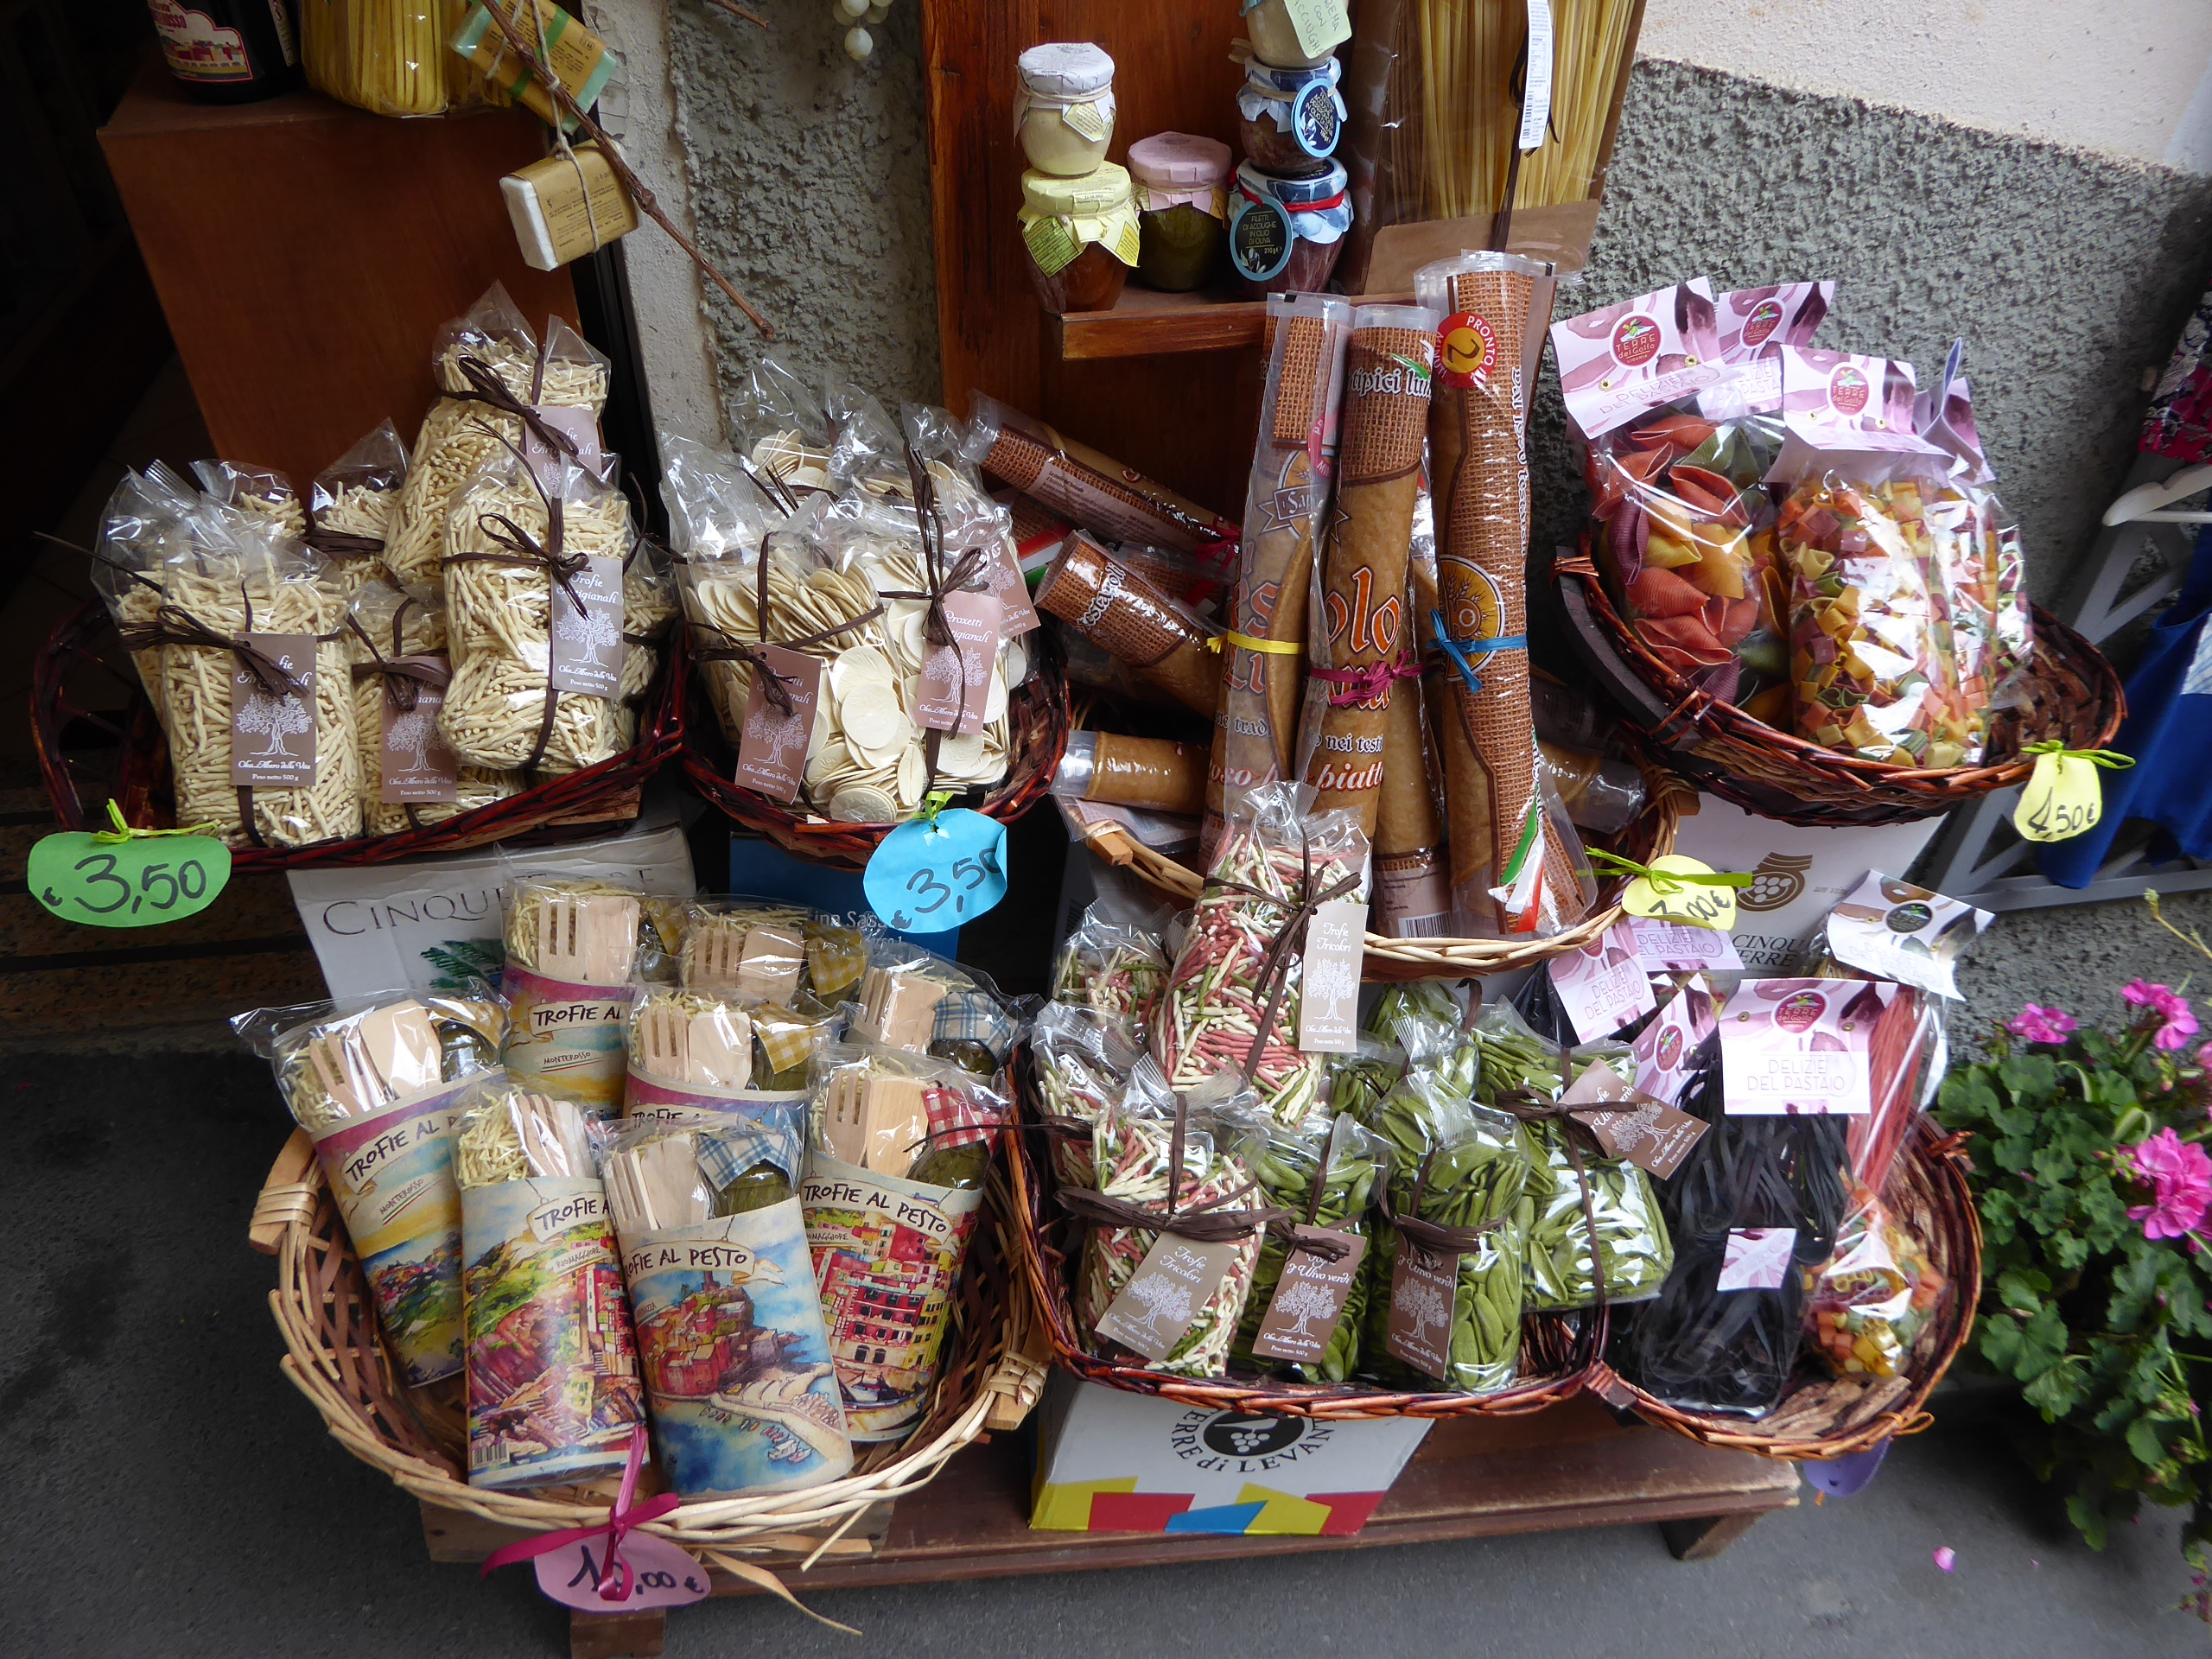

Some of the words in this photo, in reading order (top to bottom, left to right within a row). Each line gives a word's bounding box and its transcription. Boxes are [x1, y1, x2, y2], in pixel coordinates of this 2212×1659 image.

[1313, 4, 1328, 28] CON
[1249, 221, 1277, 230] ACCIUGHE
[1745, 320, 1776, 336] TERRE
[1466, 315, 1495, 366] PRONTO
[1615, 334, 1656, 353] TERRE
[1446, 338, 1480, 363] 2
[1618, 346, 1631, 359] del
[1631, 342, 1656, 356] Golfo
[1599, 398, 1631, 415] DEL
[1637, 374, 1712, 402] PASTAIO
[1615, 372, 1683, 403] DELIZIE
[1833, 385, 1866, 399] TERRE
[569, 570, 604, 589] Trofie
[570, 678, 583, 688] Peso
[583, 680, 595, 690] netto
[595, 681, 606, 690] 500
[605, 671, 618, 683] Vita
[279, 760, 296, 770] della
[295, 760, 312, 771] Vita
[73, 853, 207, 915] 3,50
[1323, 922, 1350, 940] Trofie
[1637, 930, 1692, 944] DELIZIE
[1317, 937, 1352, 952] Tricolori
[1657, 942, 1715, 956] PASTAIO
[1735, 950, 1799, 969] ERRE
[1591, 969, 1628, 1000] DELIZIE
[1584, 1001, 1608, 1020] DEL
[1606, 981, 1642, 1013] PASTAIO
[532, 1004, 599, 1027] TROFIE
[1778, 1007, 1818, 1017] TERRE
[543, 1051, 592, 1065] MONTEROSSO
[1768, 1058, 1827, 1074] DELIZIE
[1747, 1075, 1779, 1090] DEL
[1783, 1075, 1846, 1090] PASTAIO
[346, 1130, 410, 1182] TROFIE
[415, 1118, 441, 1141] AL
[379, 1178, 425, 1215] MONTEROSSO
[535, 1197, 598, 1231] TROFIE
[804, 1183, 861, 1205] TROFIE
[867, 1191, 891, 1209] AL
[897, 1205, 949, 1234] PESTO
[555, 1245, 601, 1268] RIOMAGGIORE
[658, 1248, 683, 1266] AL
[689, 1247, 748, 1267] PESTO
[1174, 1245, 1208, 1271] Trofie
[1160, 1254, 1204, 1284] Tricolori
[1327, 1272, 1352, 1285] verdi
[1432, 1273, 1456, 1289] verdi
[1270, 1344, 1283, 1353] Peso
[1294, 1349, 1305, 1357] 500
[1196, 1456, 1230, 1472] di
